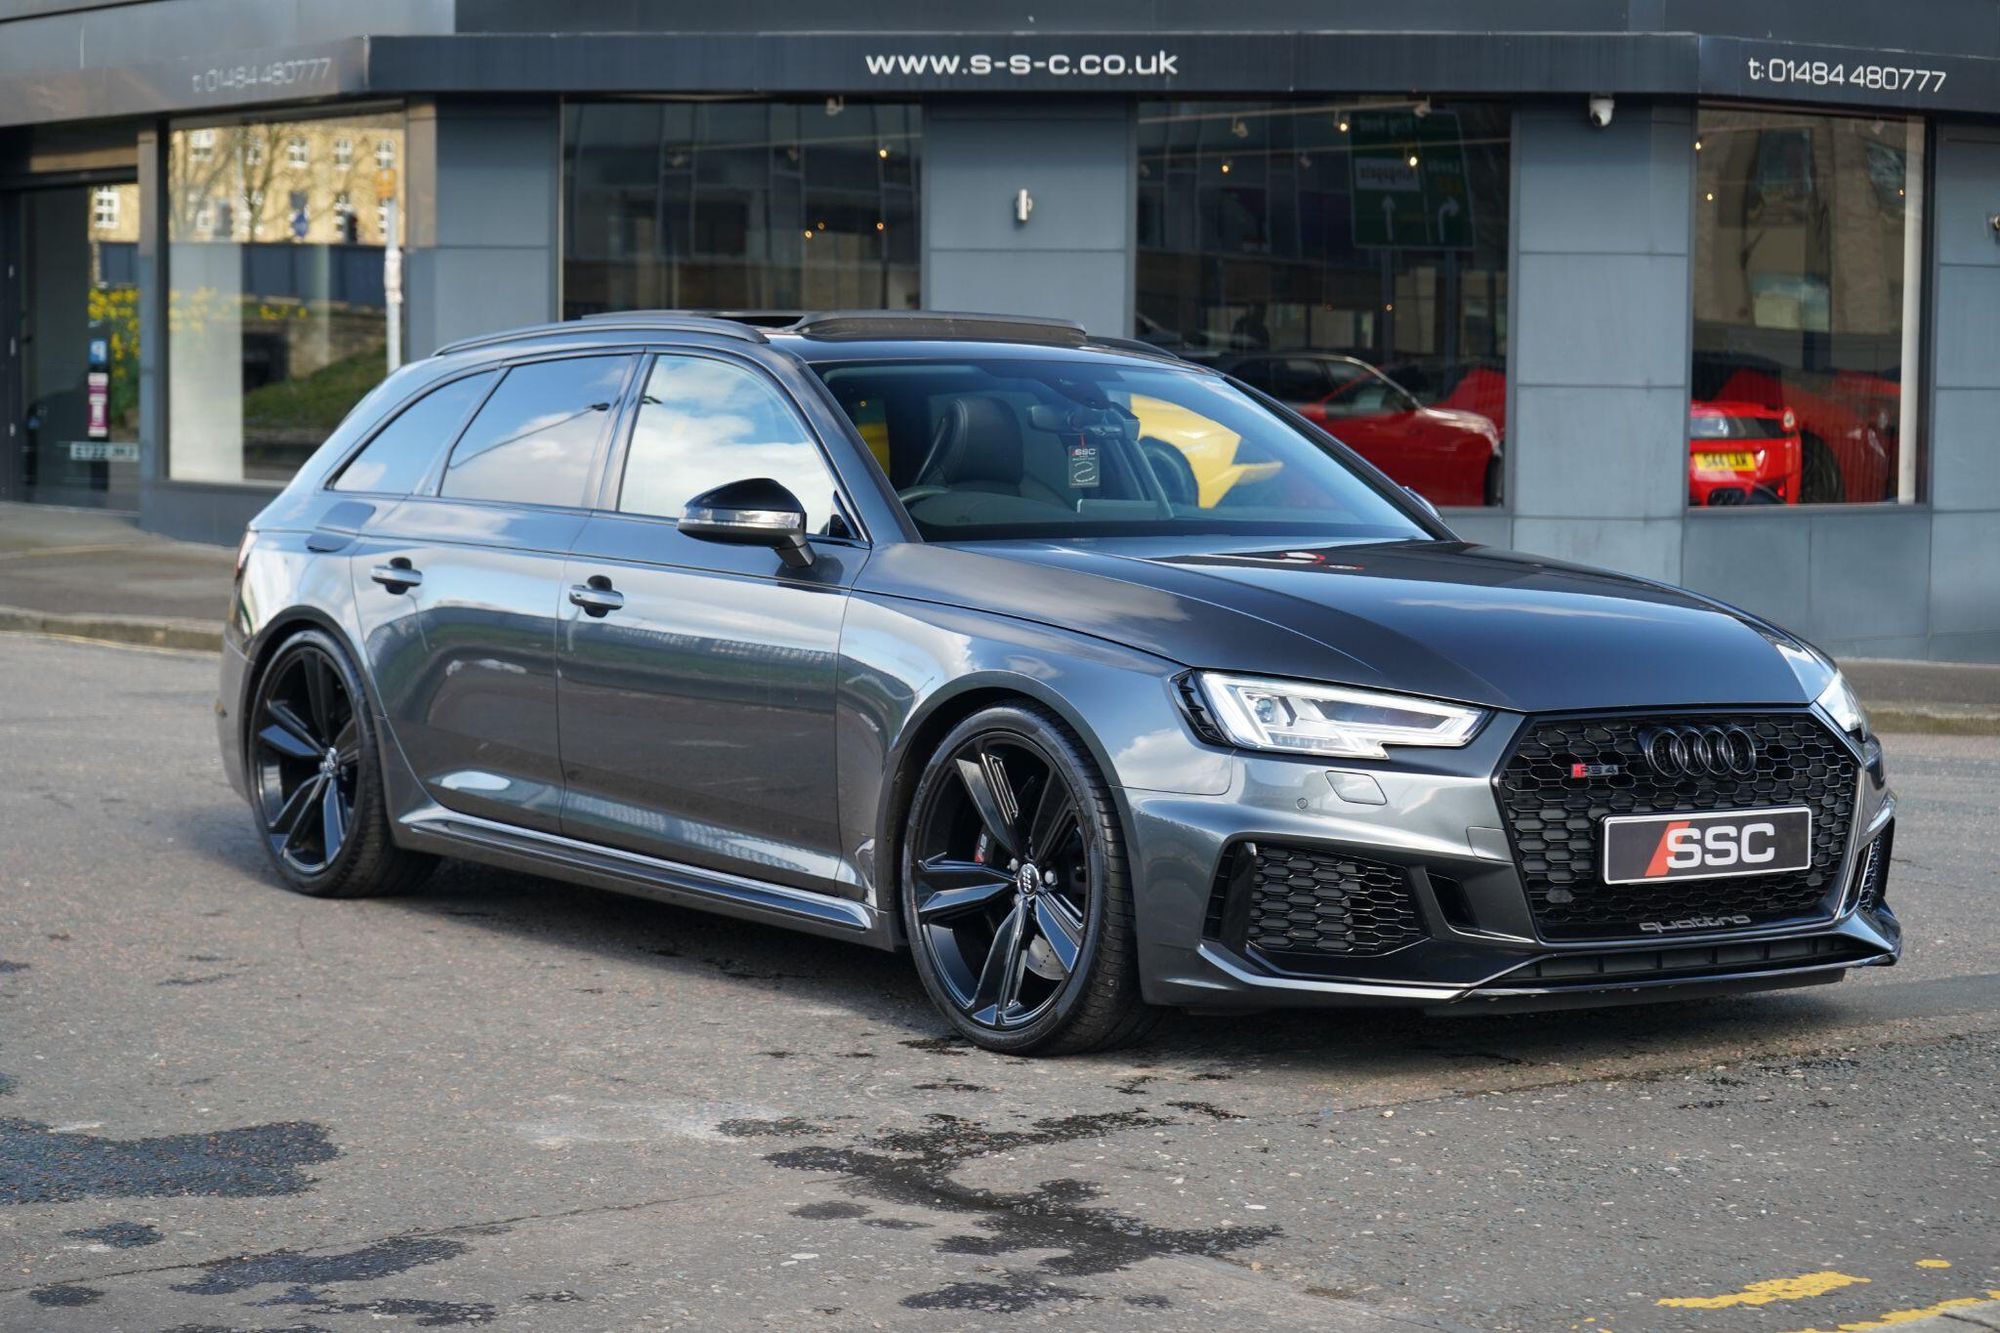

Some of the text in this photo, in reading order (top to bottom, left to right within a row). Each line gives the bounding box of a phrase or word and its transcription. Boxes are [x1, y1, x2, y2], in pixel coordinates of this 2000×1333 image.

[260, 57, 331, 85] 480777
[866, 50, 1178, 74] www.s-s-c.co.uk
[1850, 65, 1947, 93] 480777
[1666, 823, 1775, 868] SSC
[1639, 915, 1751, 933] quattro
